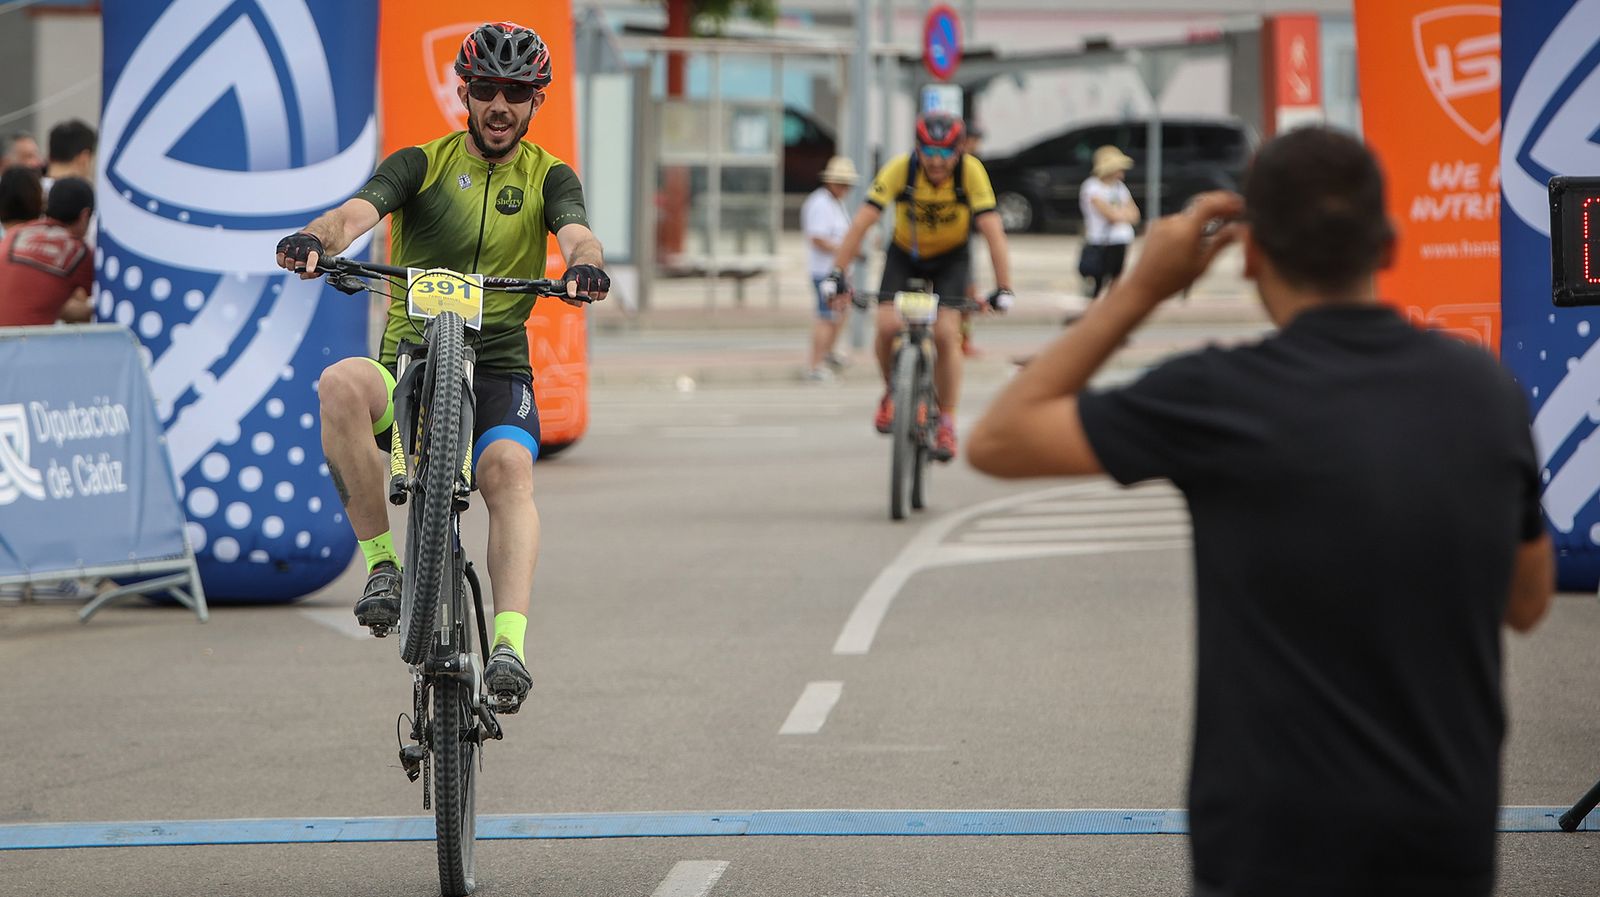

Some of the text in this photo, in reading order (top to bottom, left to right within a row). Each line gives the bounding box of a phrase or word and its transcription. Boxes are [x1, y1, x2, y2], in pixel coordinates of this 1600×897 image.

[1429, 161, 1481, 191] WE
[1410, 192, 1501, 222] NUTRI
[417, 280, 471, 299] 391
[29, 397, 130, 447] Diputación
[47, 452, 128, 499] de Cádiz
